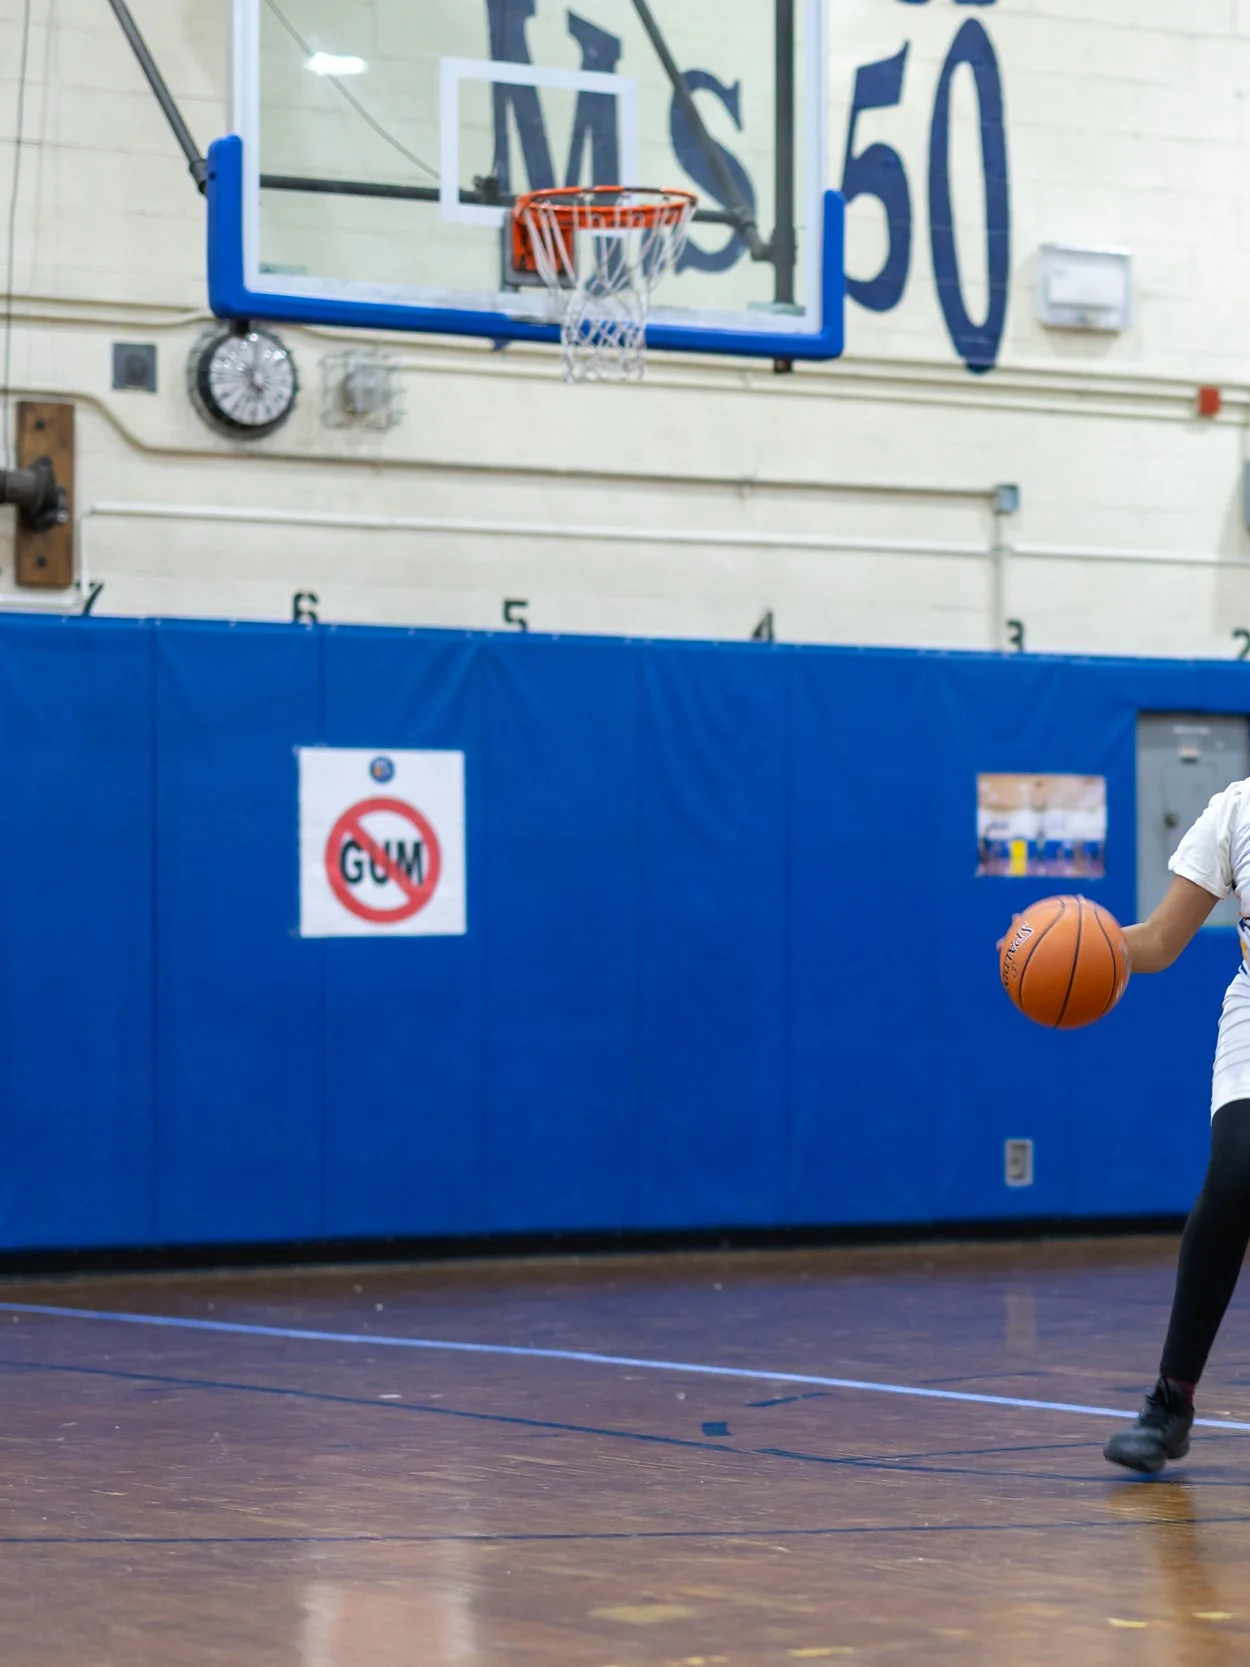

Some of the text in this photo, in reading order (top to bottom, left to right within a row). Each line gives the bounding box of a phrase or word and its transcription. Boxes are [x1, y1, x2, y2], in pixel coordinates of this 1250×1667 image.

[485, 0, 1010, 374] MS 50
[76, 580, 104, 616] 7
[292, 588, 319, 624] 6
[503, 598, 528, 633] 5
[752, 609, 774, 643] 4
[1006, 620, 1025, 654] 3
[339, 838, 424, 886] GUM
